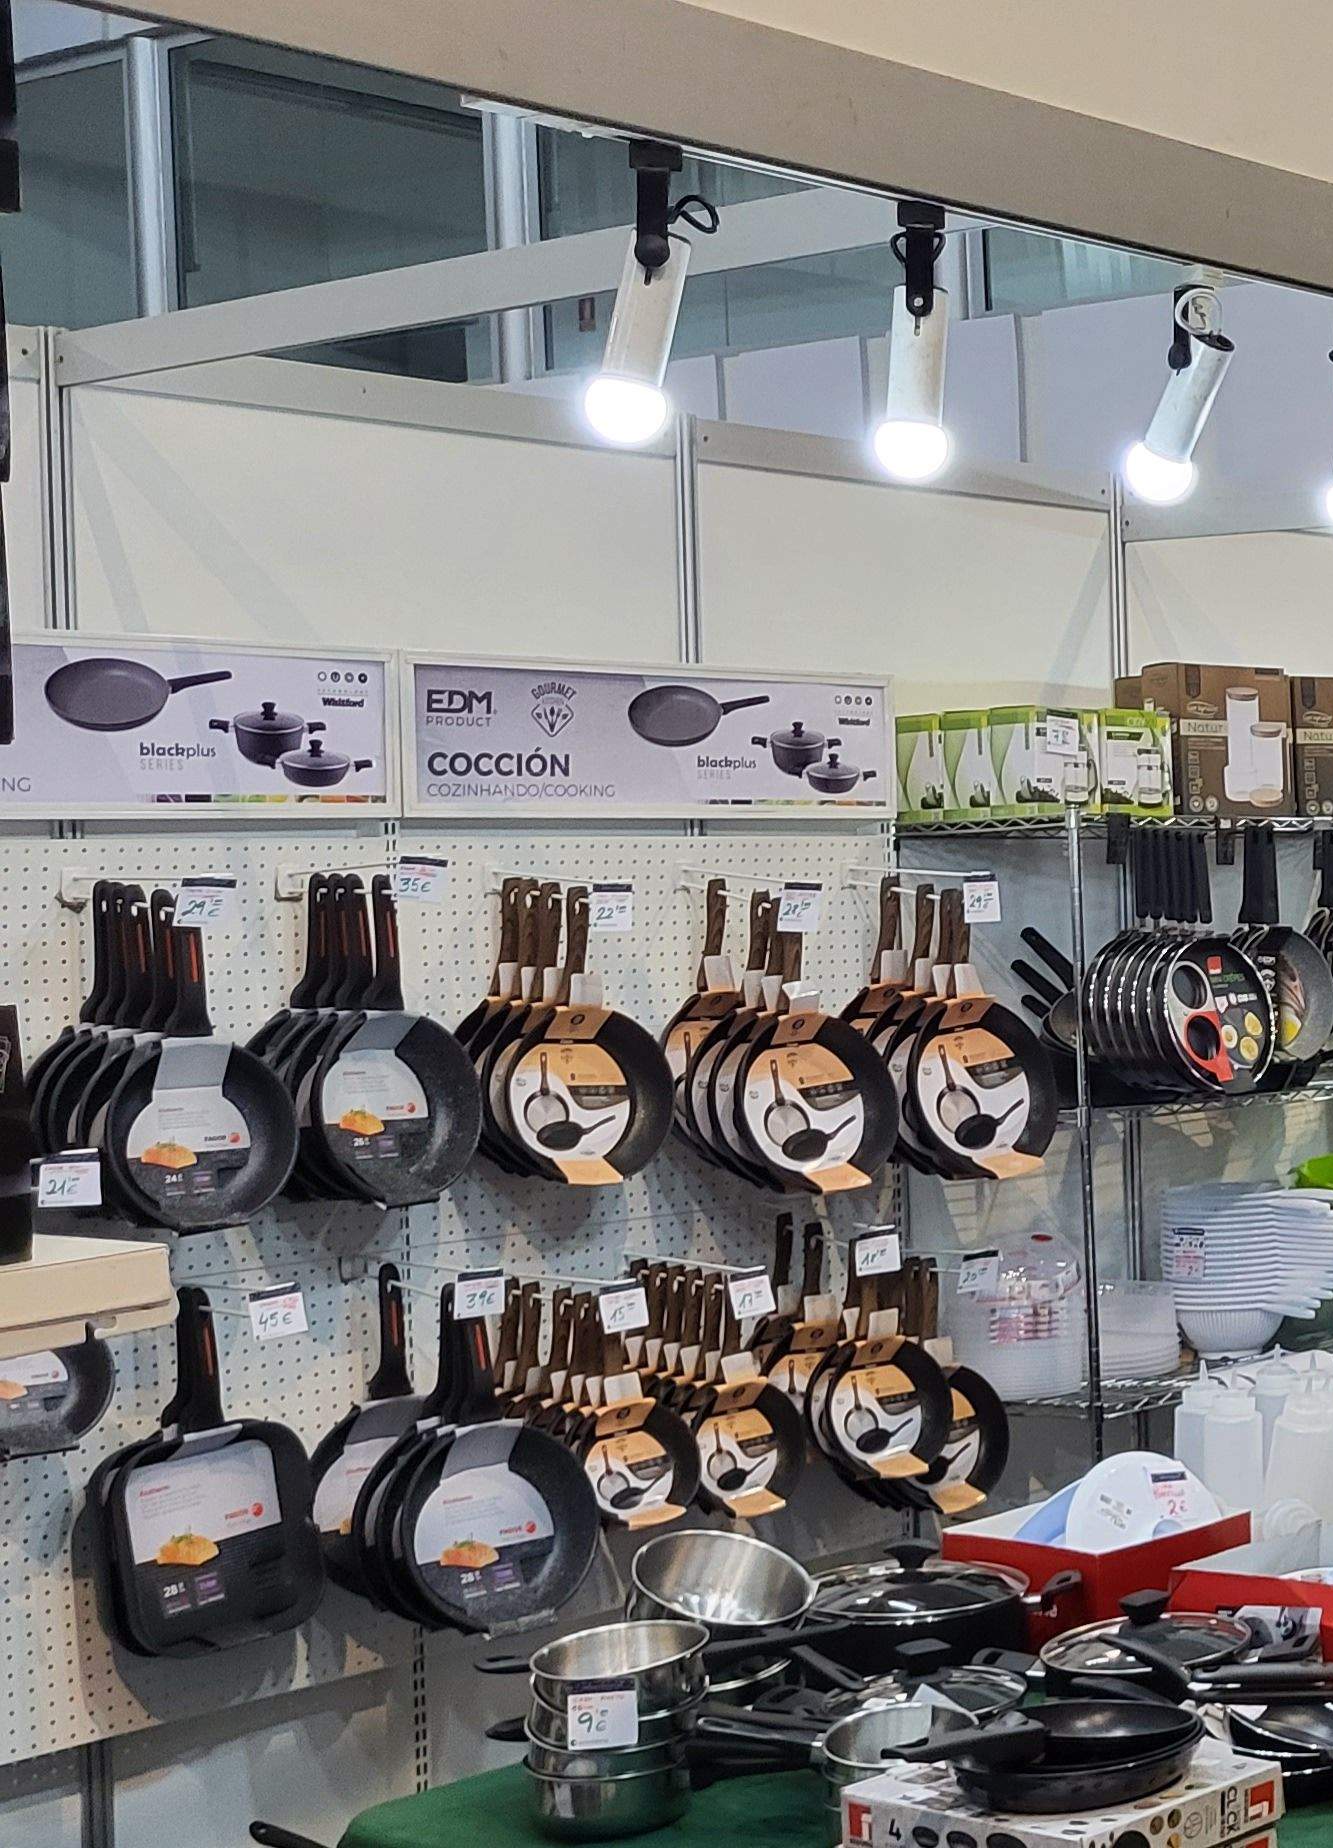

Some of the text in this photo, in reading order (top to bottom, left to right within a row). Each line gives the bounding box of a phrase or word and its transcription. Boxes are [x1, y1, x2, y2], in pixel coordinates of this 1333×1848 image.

[531, 682, 577, 700] GOURMET
[427, 689, 492, 714] EDM
[426, 716, 492, 727] PRODUCT
[139, 742, 216, 759] blackplus
[139, 759, 184, 771] SERIES
[427, 747, 570, 777] COCCIÓN
[697, 755, 757, 770] blackplus
[427, 782, 616, 798] COZINHANDO/COOKING
